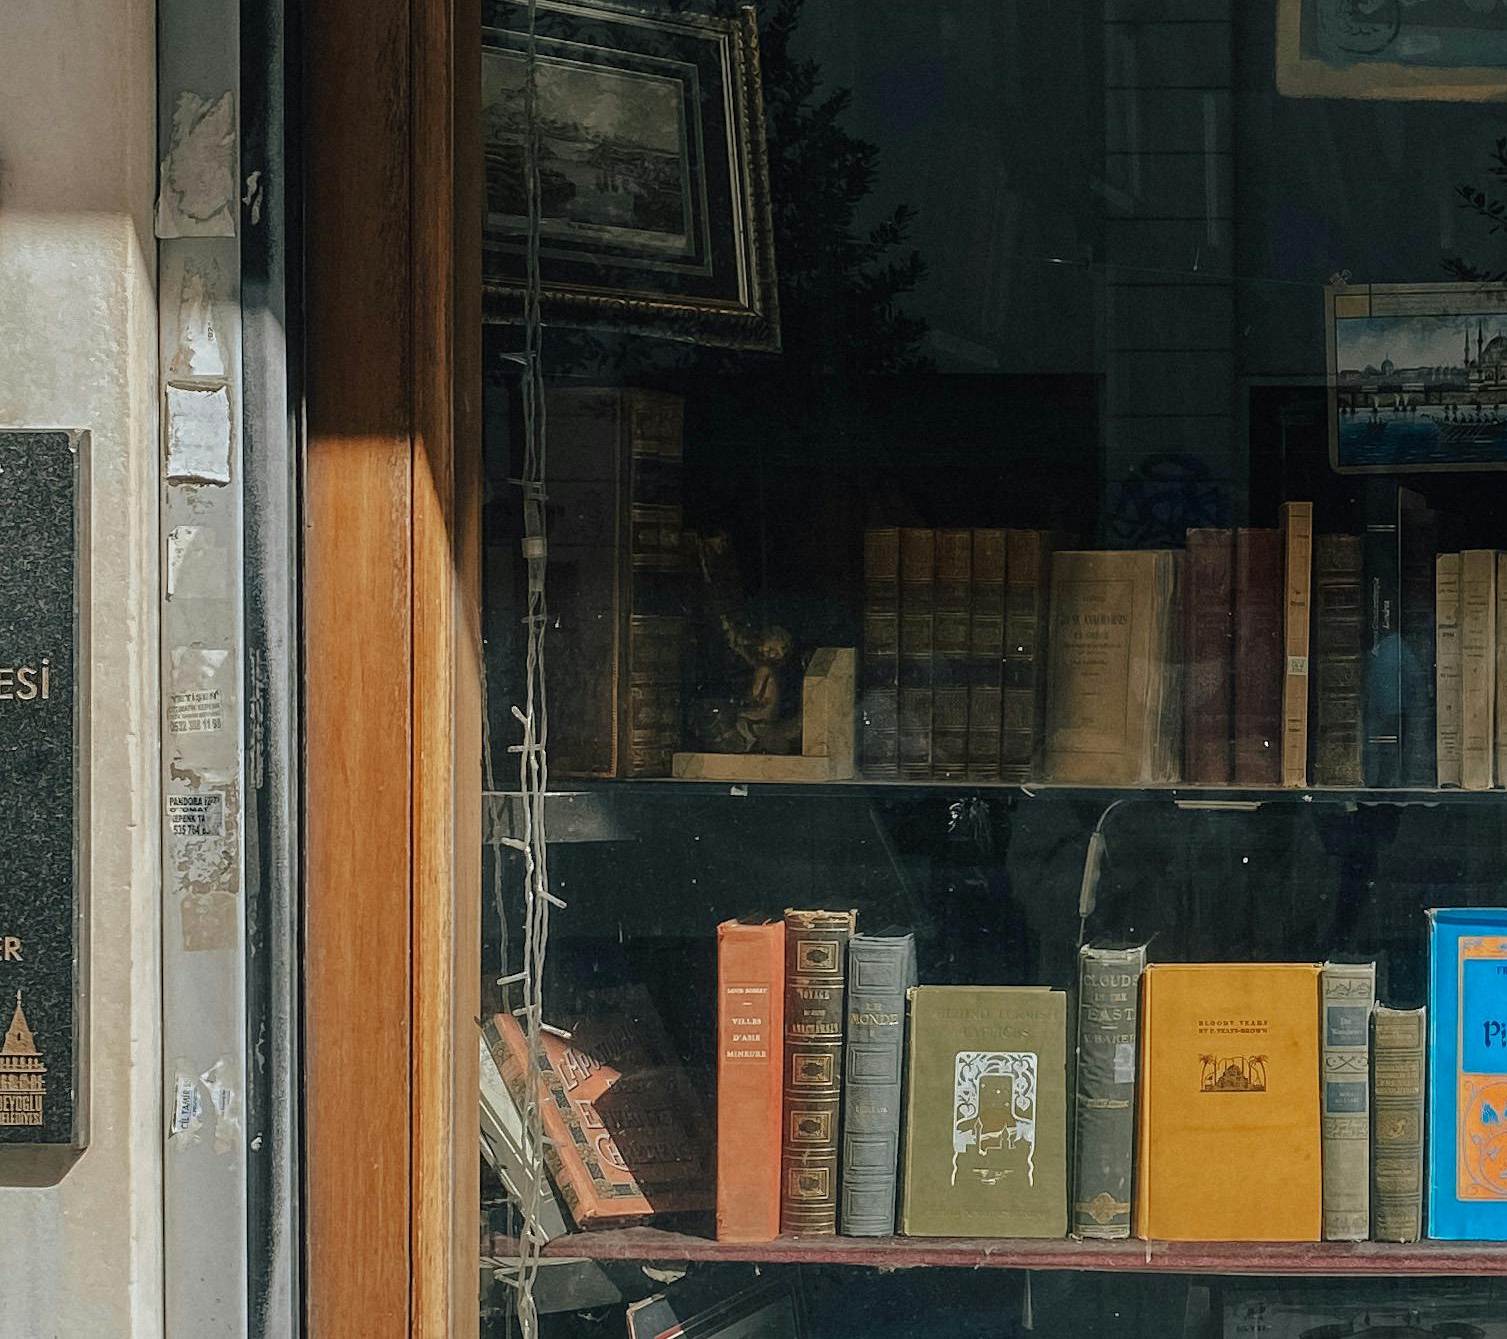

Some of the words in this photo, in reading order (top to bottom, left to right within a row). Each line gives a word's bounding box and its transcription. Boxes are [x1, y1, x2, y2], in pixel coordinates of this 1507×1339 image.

[1083, 974, 1139, 988] CLOUDS
[851, 1013, 899, 1025] MONDE
[1088, 1007, 1134, 1021] EAST
